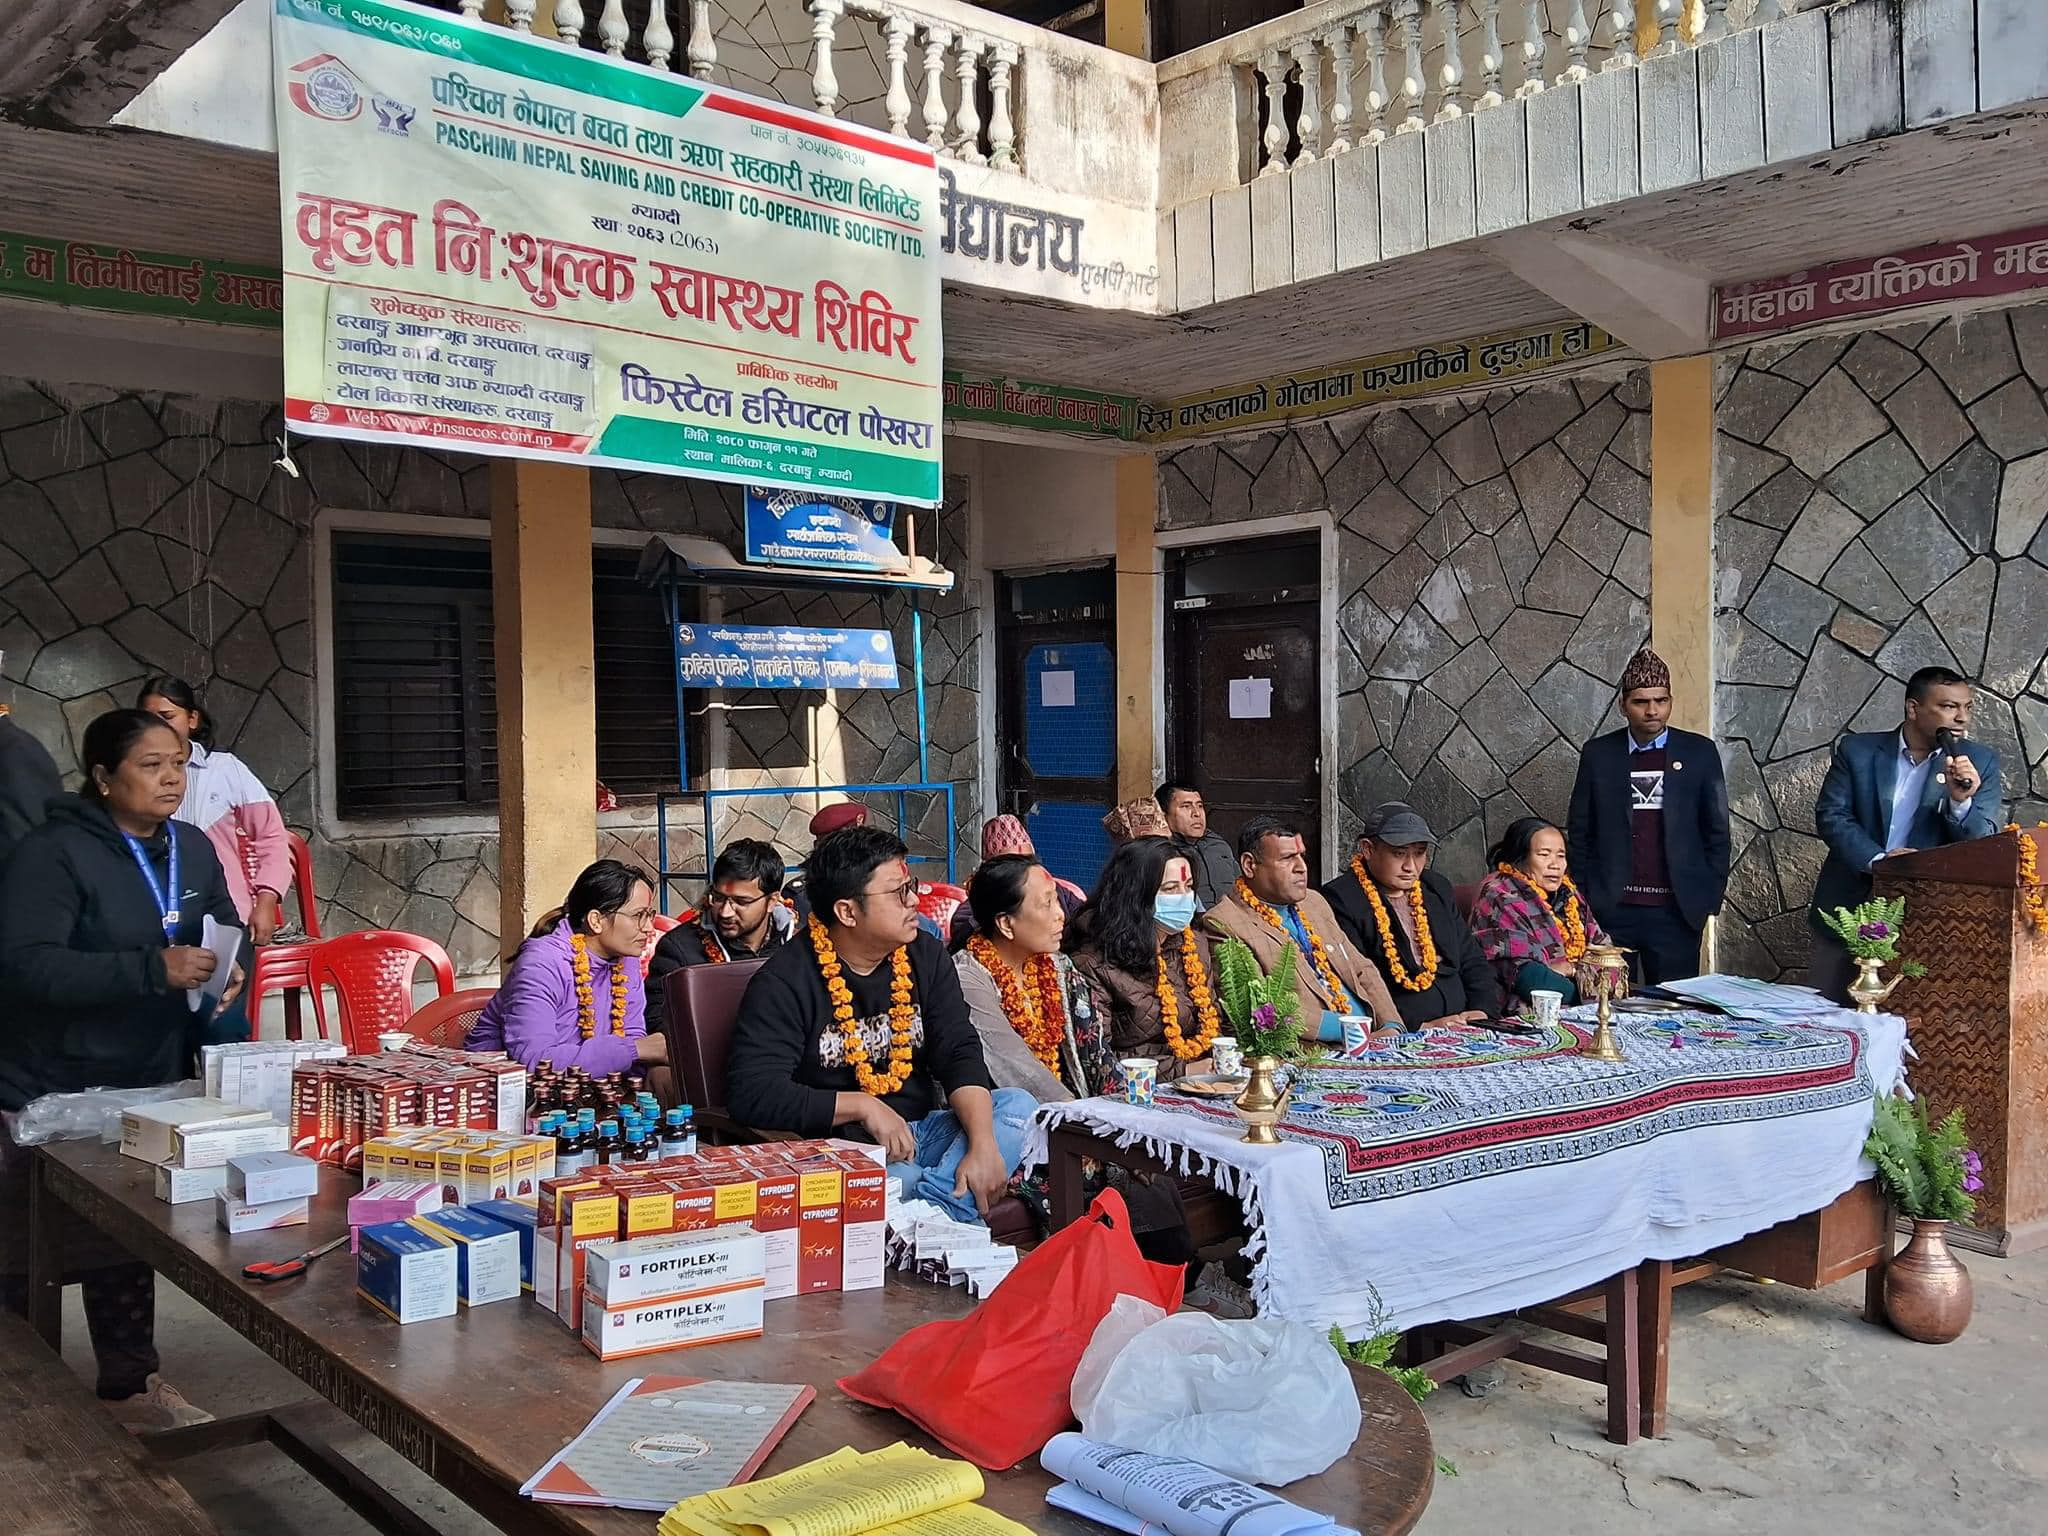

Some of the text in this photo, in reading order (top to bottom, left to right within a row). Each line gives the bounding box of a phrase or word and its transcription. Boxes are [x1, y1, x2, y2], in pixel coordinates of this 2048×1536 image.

[430, 71, 923, 222] पश्चिम नेपाल बचत तथा ऋण सहकारी संस्था लिमिटेड
[750, 124, 773, 141] पान
[435, 121, 926, 259] PASCHIM NEPAL SAVING AND CREDIT CO-OPERATIVE SOCIETY LTD.
[631, 203, 681, 226] म्याग्दी
[627, 224, 665, 243] २०६३
[670, 230, 719, 255] (2063)
[65, 241, 204, 306] तिमीलाई
[1722, 281, 1818, 324] महान
[1828, 243, 1982, 304] व्यक्तिको
[648, 260, 804, 339] स्वास्थ्य
[814, 279, 920, 365] शिविर
[337, 337, 397, 357] जनप्रिय
[337, 361, 398, 381] लायन्स
[736, 361, 838, 391] प्राविधिक सहयोग
[1136, 403, 1174, 435] रिस
[1275, 378, 1355, 409] गोलामा
[1561, 322, 1593, 356] हो
[337, 382, 370, 401] टोल
[375, 386, 428, 407] विकास
[620, 363, 934, 449] फिस्टेल हस्पिटल पोखरा
[962, 380, 998, 411] लागि
[386, 414, 553, 448] www.pnsaccos.com.np
[716, 434, 744, 447] २०८०
[801, 446, 818, 459] गते
[292, 1081, 300, 1137] Multiplex
[320, 1081, 328, 1138] Multiplex
[759, 1184, 796, 1196] CYPROHEP
[848, 1177, 883, 1188] CYPROHEP
[675, 1196, 713, 1209] CYPROHEP
[802, 1207, 839, 1220] CYPROHEP
